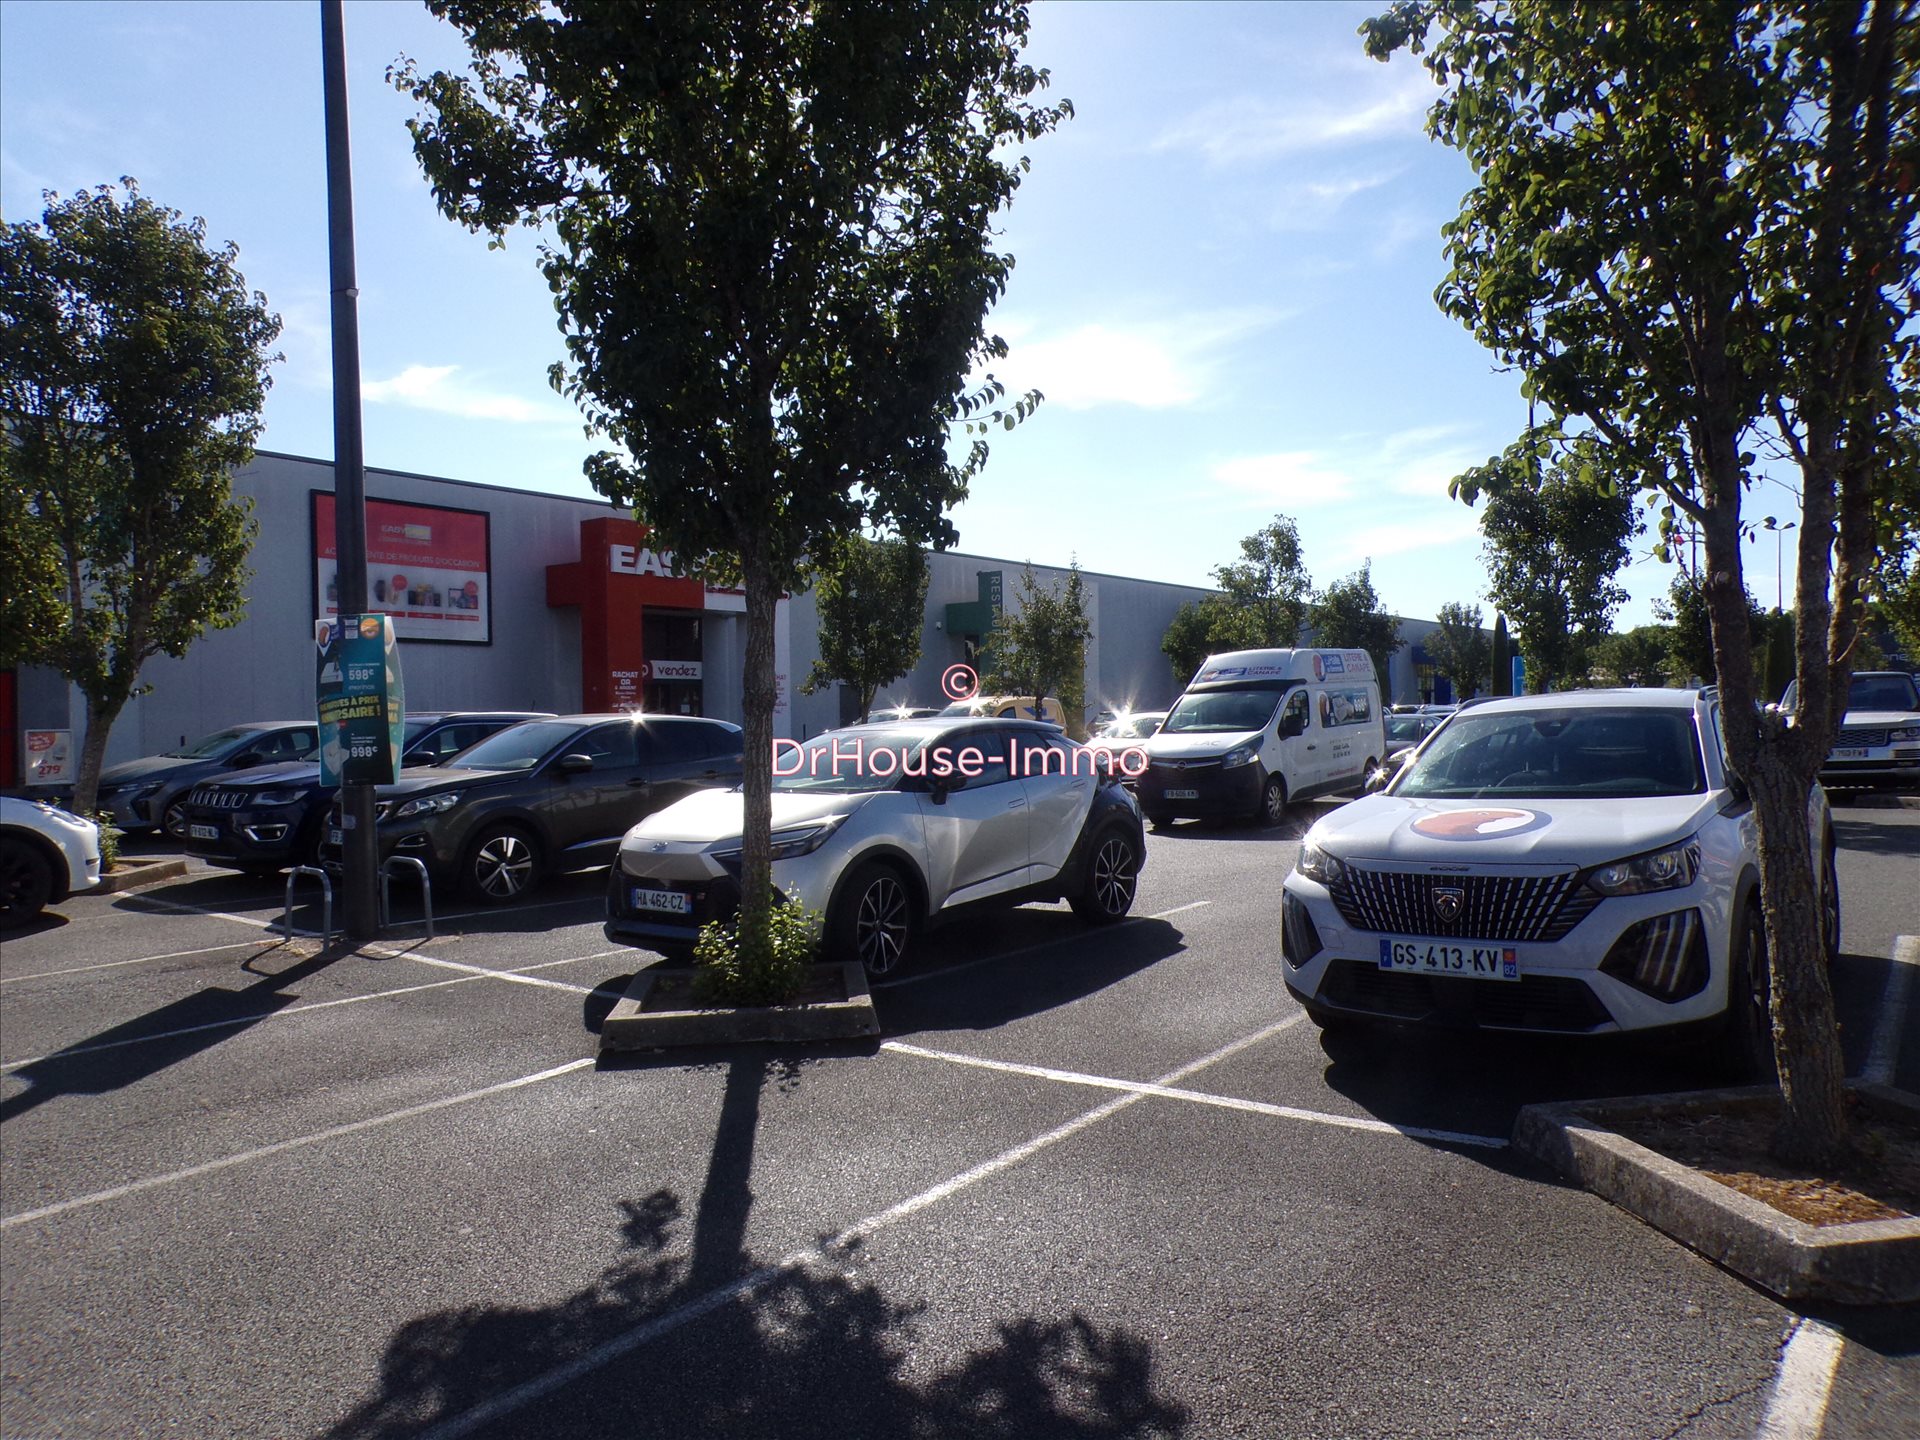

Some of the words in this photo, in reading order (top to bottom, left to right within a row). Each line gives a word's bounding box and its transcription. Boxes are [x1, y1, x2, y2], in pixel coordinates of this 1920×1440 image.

[610, 543, 703, 580] EAS
[612, 671, 639, 679] RACHAT
[658, 664, 697, 676] vendez
[620, 678, 631, 686] OR
[359, 695, 379, 706] PRIX
[636, 891, 684, 910] HA-462-CZ
[1393, 943, 1498, 972] GS-413-KV
[1504, 964, 1517, 976] 82
